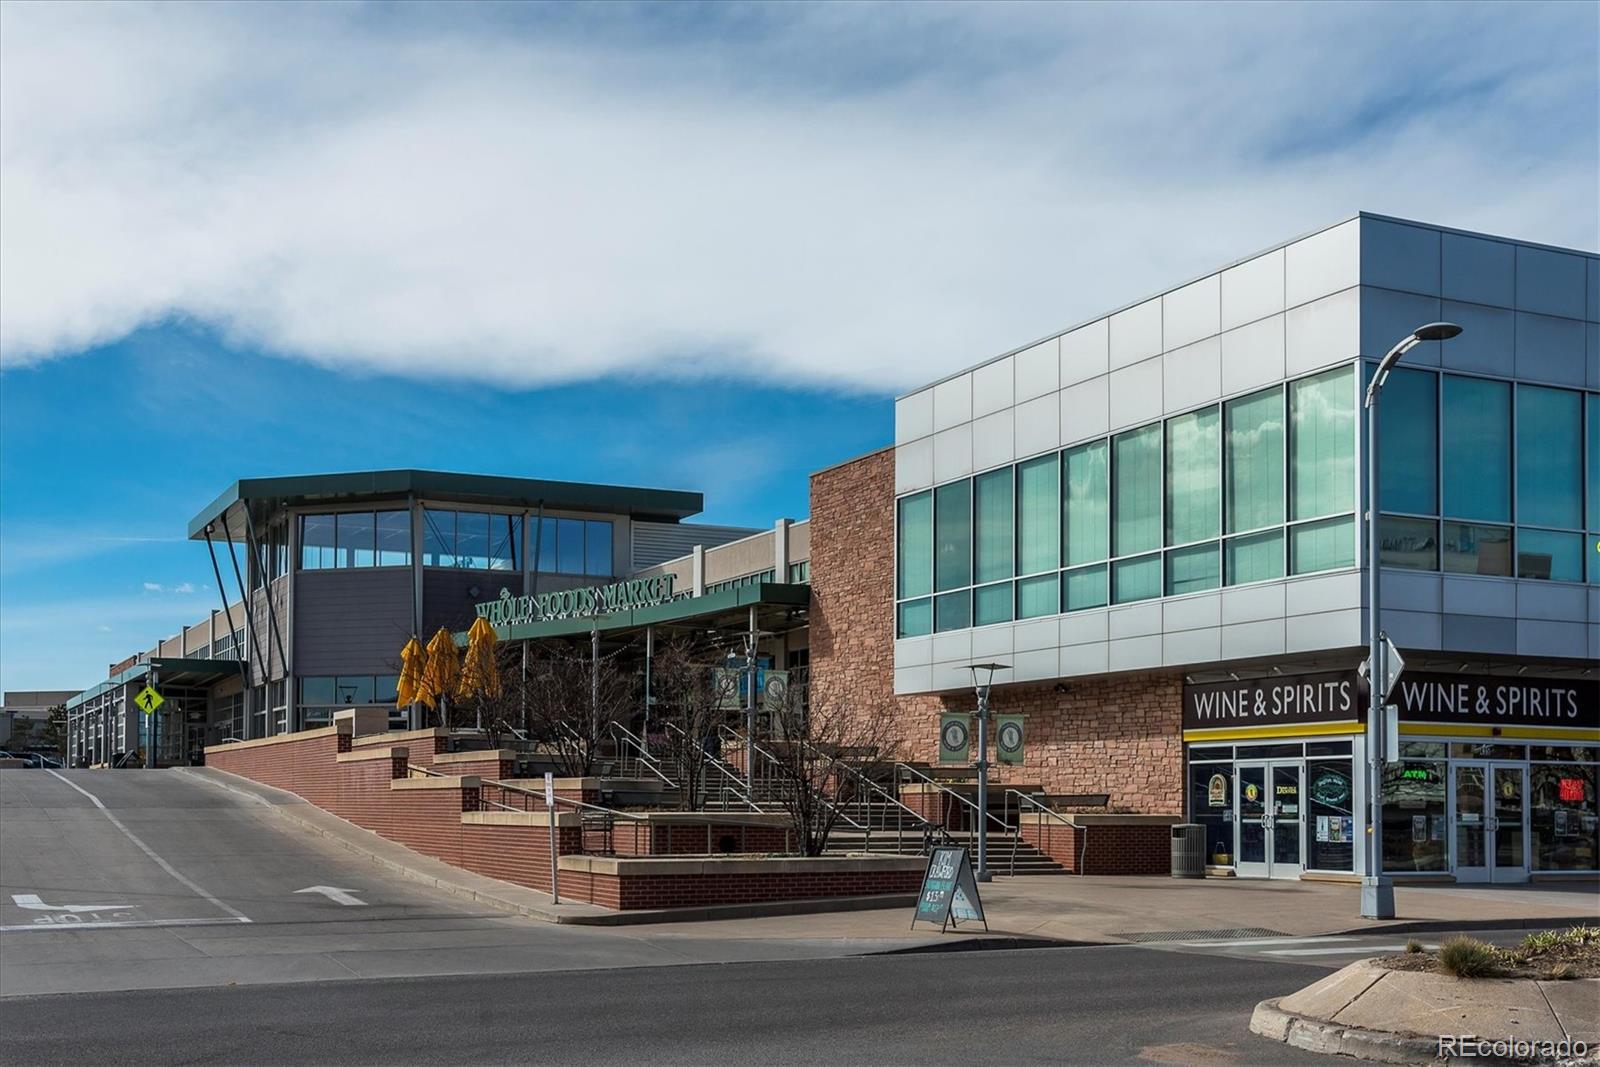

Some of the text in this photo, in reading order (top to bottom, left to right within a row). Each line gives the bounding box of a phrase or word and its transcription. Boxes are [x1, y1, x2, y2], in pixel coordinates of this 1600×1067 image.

[537, 585, 596, 618] FOODS
[602, 573, 677, 610] MARKET
[1194, 680, 1351, 720] WINE & SPIRITS
[1401, 681, 1578, 719] WINE & SPIRITS
